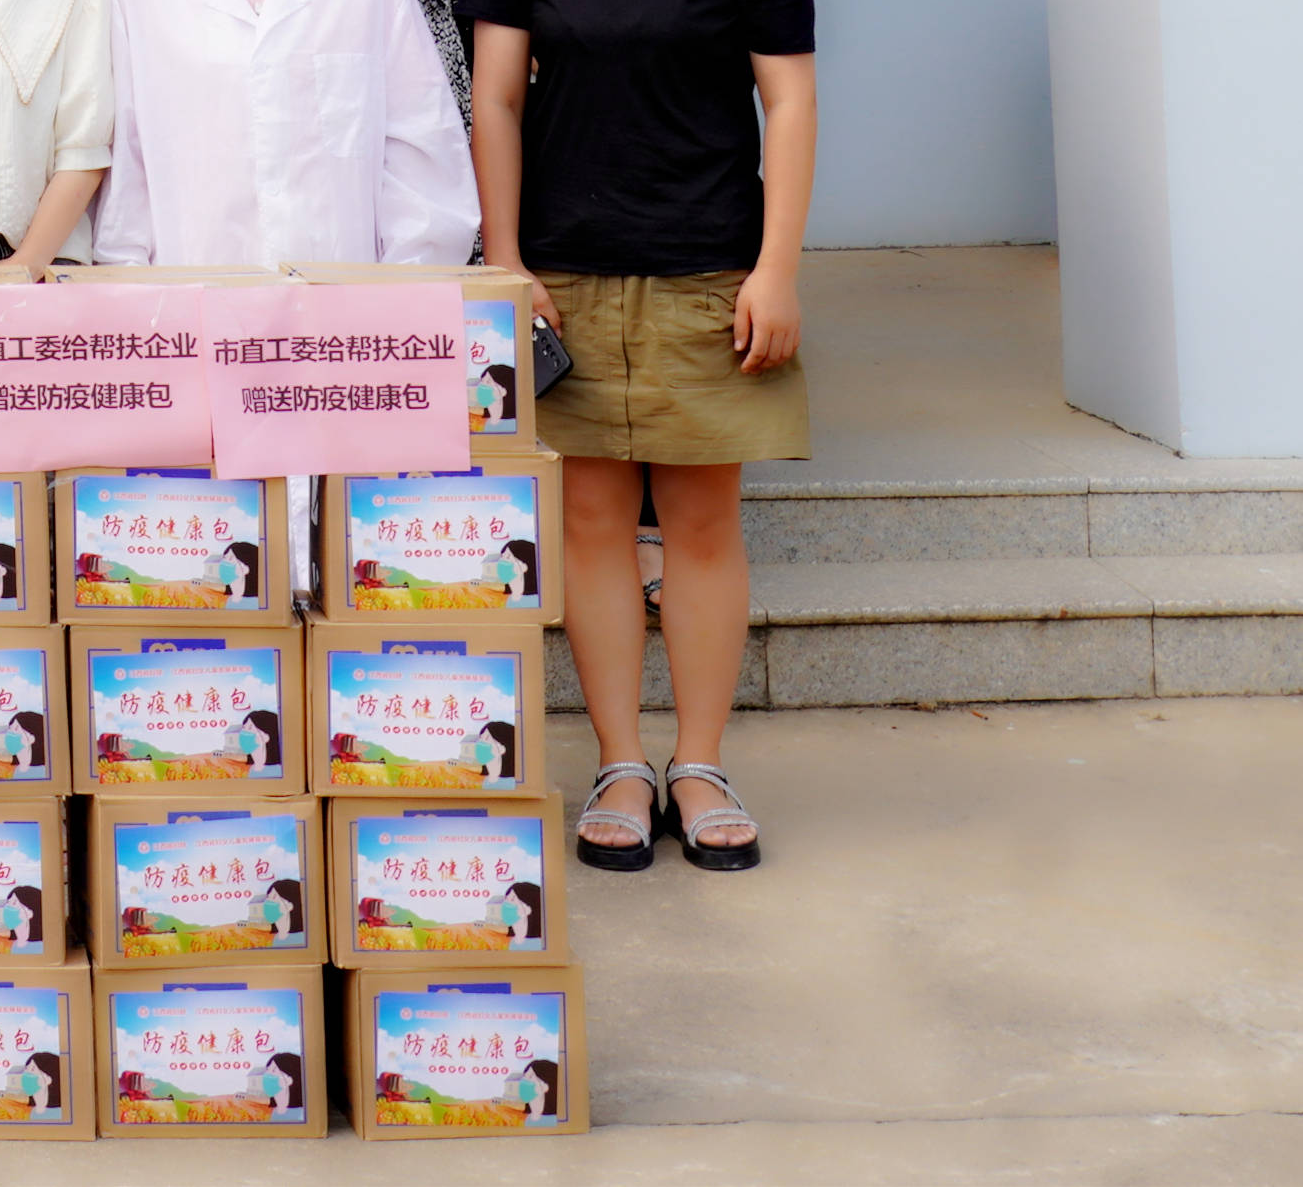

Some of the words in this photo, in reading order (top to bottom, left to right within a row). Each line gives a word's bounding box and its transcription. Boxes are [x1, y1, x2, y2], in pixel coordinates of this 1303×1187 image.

[217, 335, 454, 365] 市直工委给帮扶企业
[247, 384, 429, 413] 赠送防疫健康包
[102, 511, 233, 542] 防疫健康包
[378, 515, 509, 542] 防疫健康包
[120, 686, 251, 715] 防疫健康包
[357, 691, 489, 721] 防疫健康包
[144, 855, 275, 889] 防疫健康包
[383, 855, 514, 882] 防疫健康包
[143, 1028, 274, 1054] 防疫健康包
[403, 1030, 534, 1060] 防疫健康包
